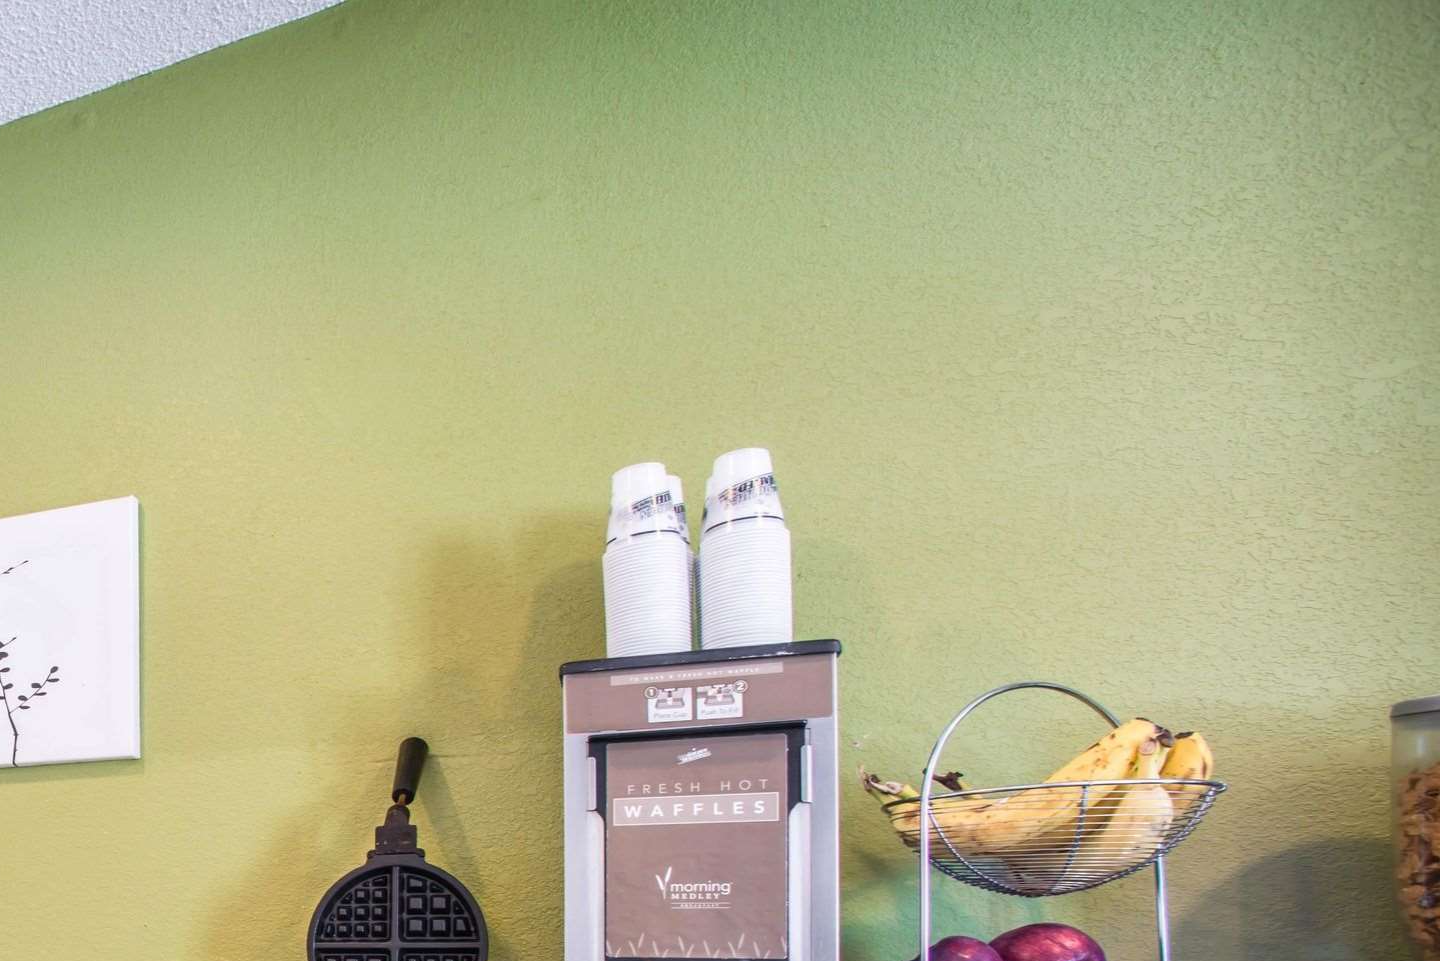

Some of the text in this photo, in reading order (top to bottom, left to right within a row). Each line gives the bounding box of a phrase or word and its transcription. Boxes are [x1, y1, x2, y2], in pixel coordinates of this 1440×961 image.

[627, 779, 769, 795] FRESH HOT
[624, 801, 766, 818] WAFFLES
[670, 880, 731, 895] morning
